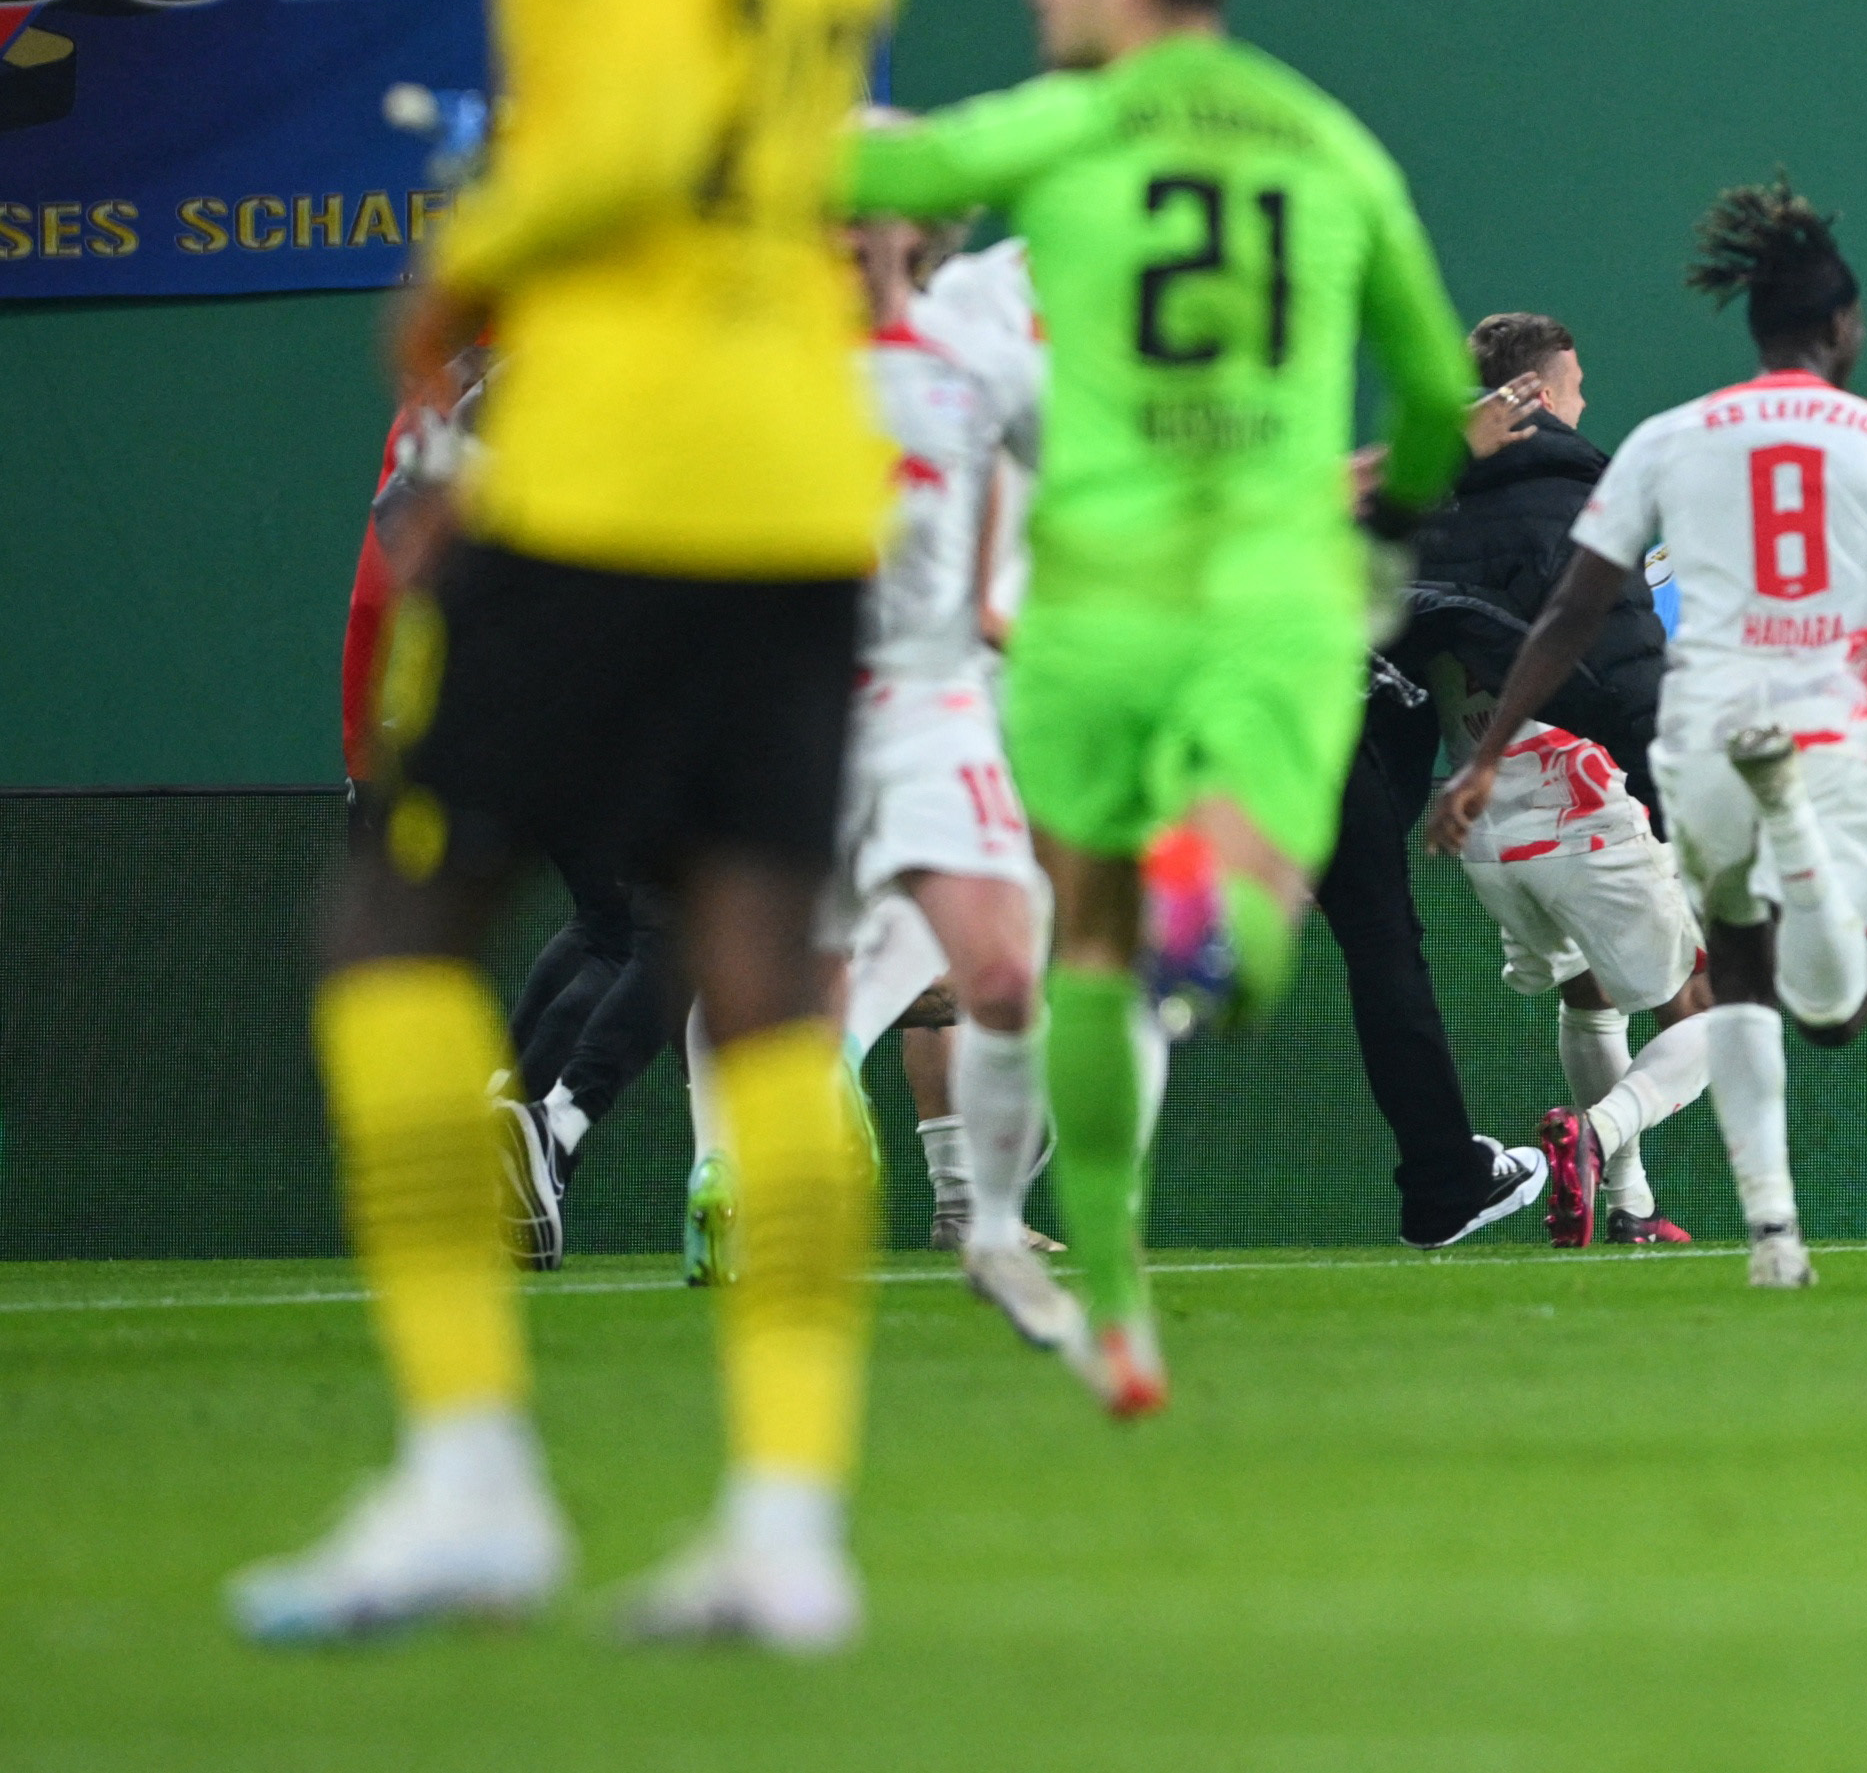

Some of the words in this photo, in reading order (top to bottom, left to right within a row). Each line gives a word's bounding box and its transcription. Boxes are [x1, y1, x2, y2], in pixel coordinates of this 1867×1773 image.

[174, 185, 466, 255] SCHAF
[1138, 174, 1290, 372] 21
[1750, 443, 1832, 602] 8
